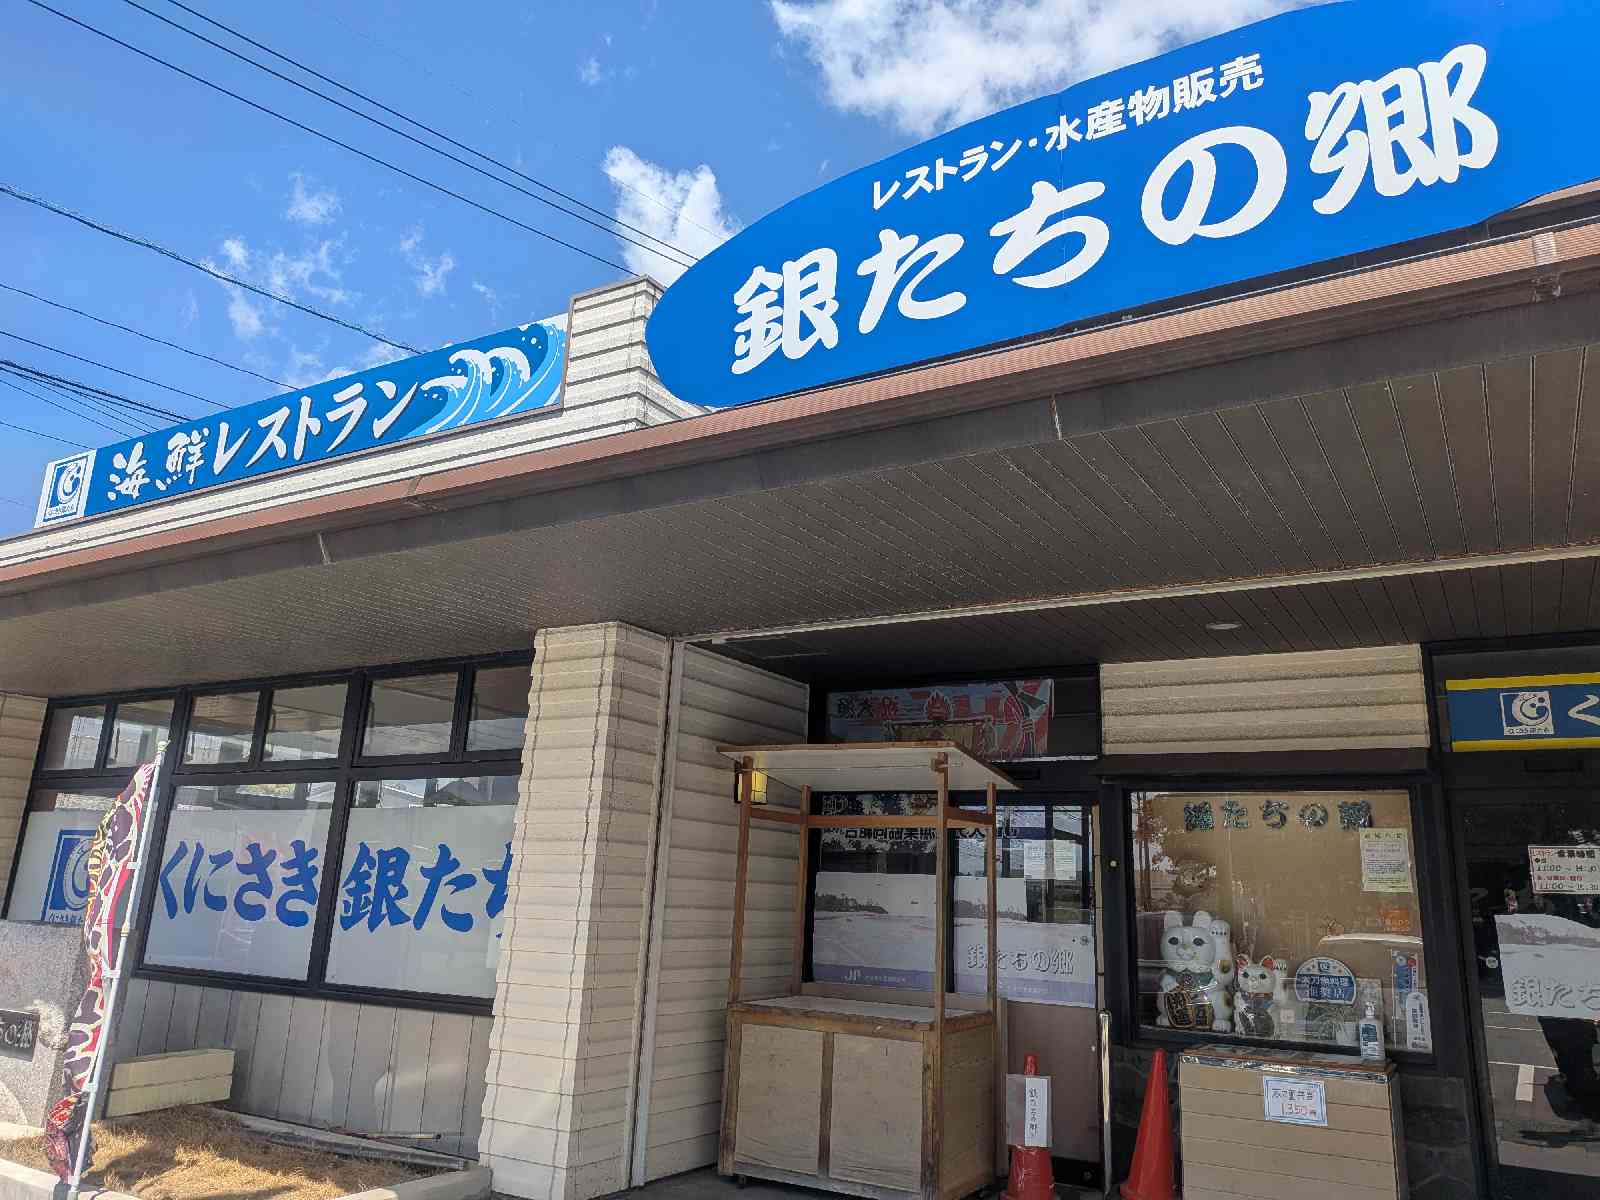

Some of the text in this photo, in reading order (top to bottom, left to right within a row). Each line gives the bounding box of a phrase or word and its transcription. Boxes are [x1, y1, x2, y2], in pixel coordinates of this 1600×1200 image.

[731, 43, 1499, 376] 銀たちの郷
[872, 53, 1265, 210] レストラン・水産物販売
[107, 380, 417, 500] 海鮮レストラン
